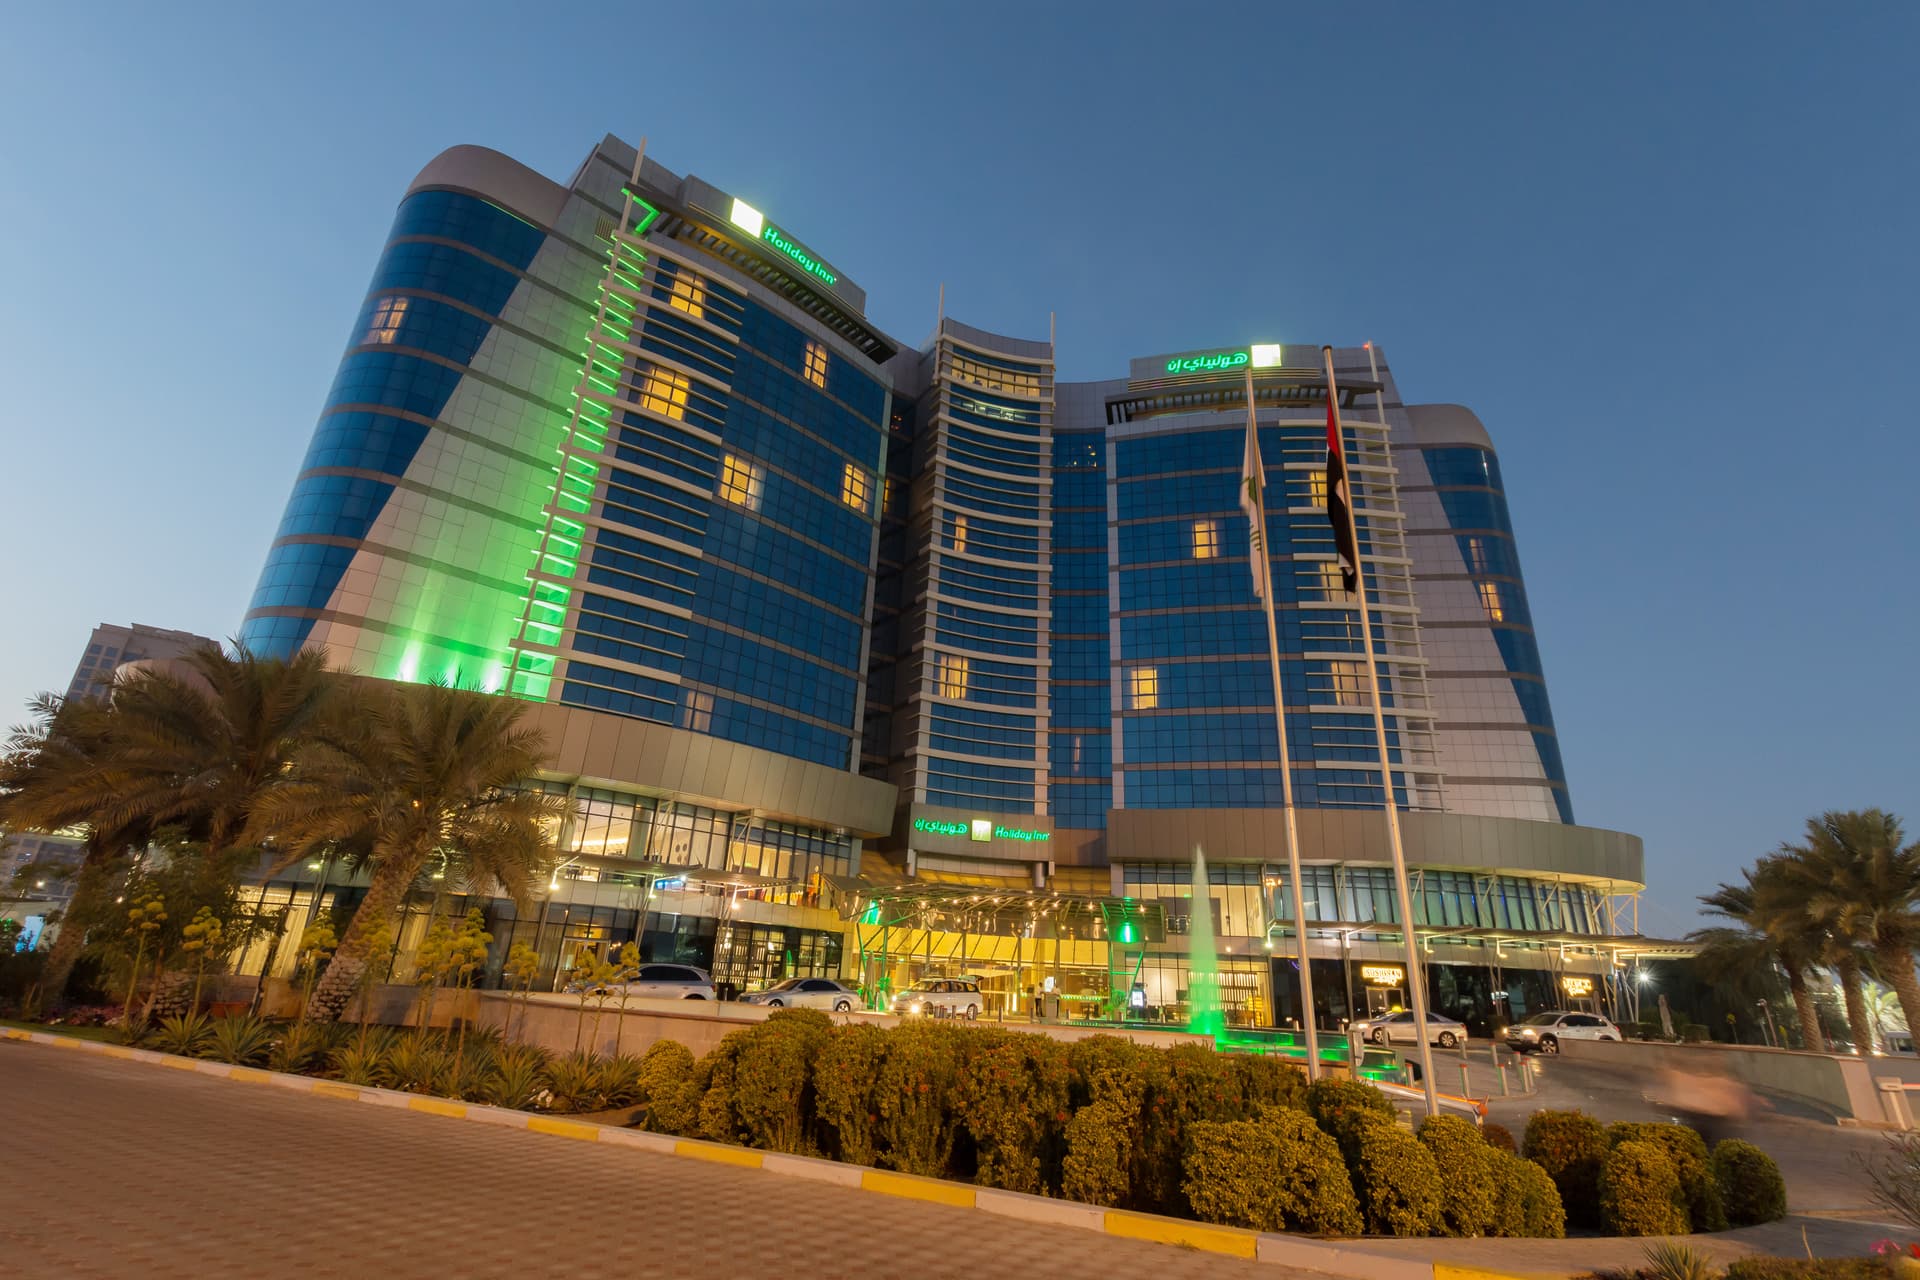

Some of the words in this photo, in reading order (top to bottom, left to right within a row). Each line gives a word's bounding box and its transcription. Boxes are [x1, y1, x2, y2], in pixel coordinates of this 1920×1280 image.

[764, 227, 815, 272] Holiday
[814, 264, 835, 285] Inn
[1167, 358, 1182, 373] إن
[1182, 352, 1249, 372] هوليداي
[925, 820, 968, 835] هوليداي
[995, 826, 1031, 842] Holiday
[1033, 831, 1049, 841] Inn
